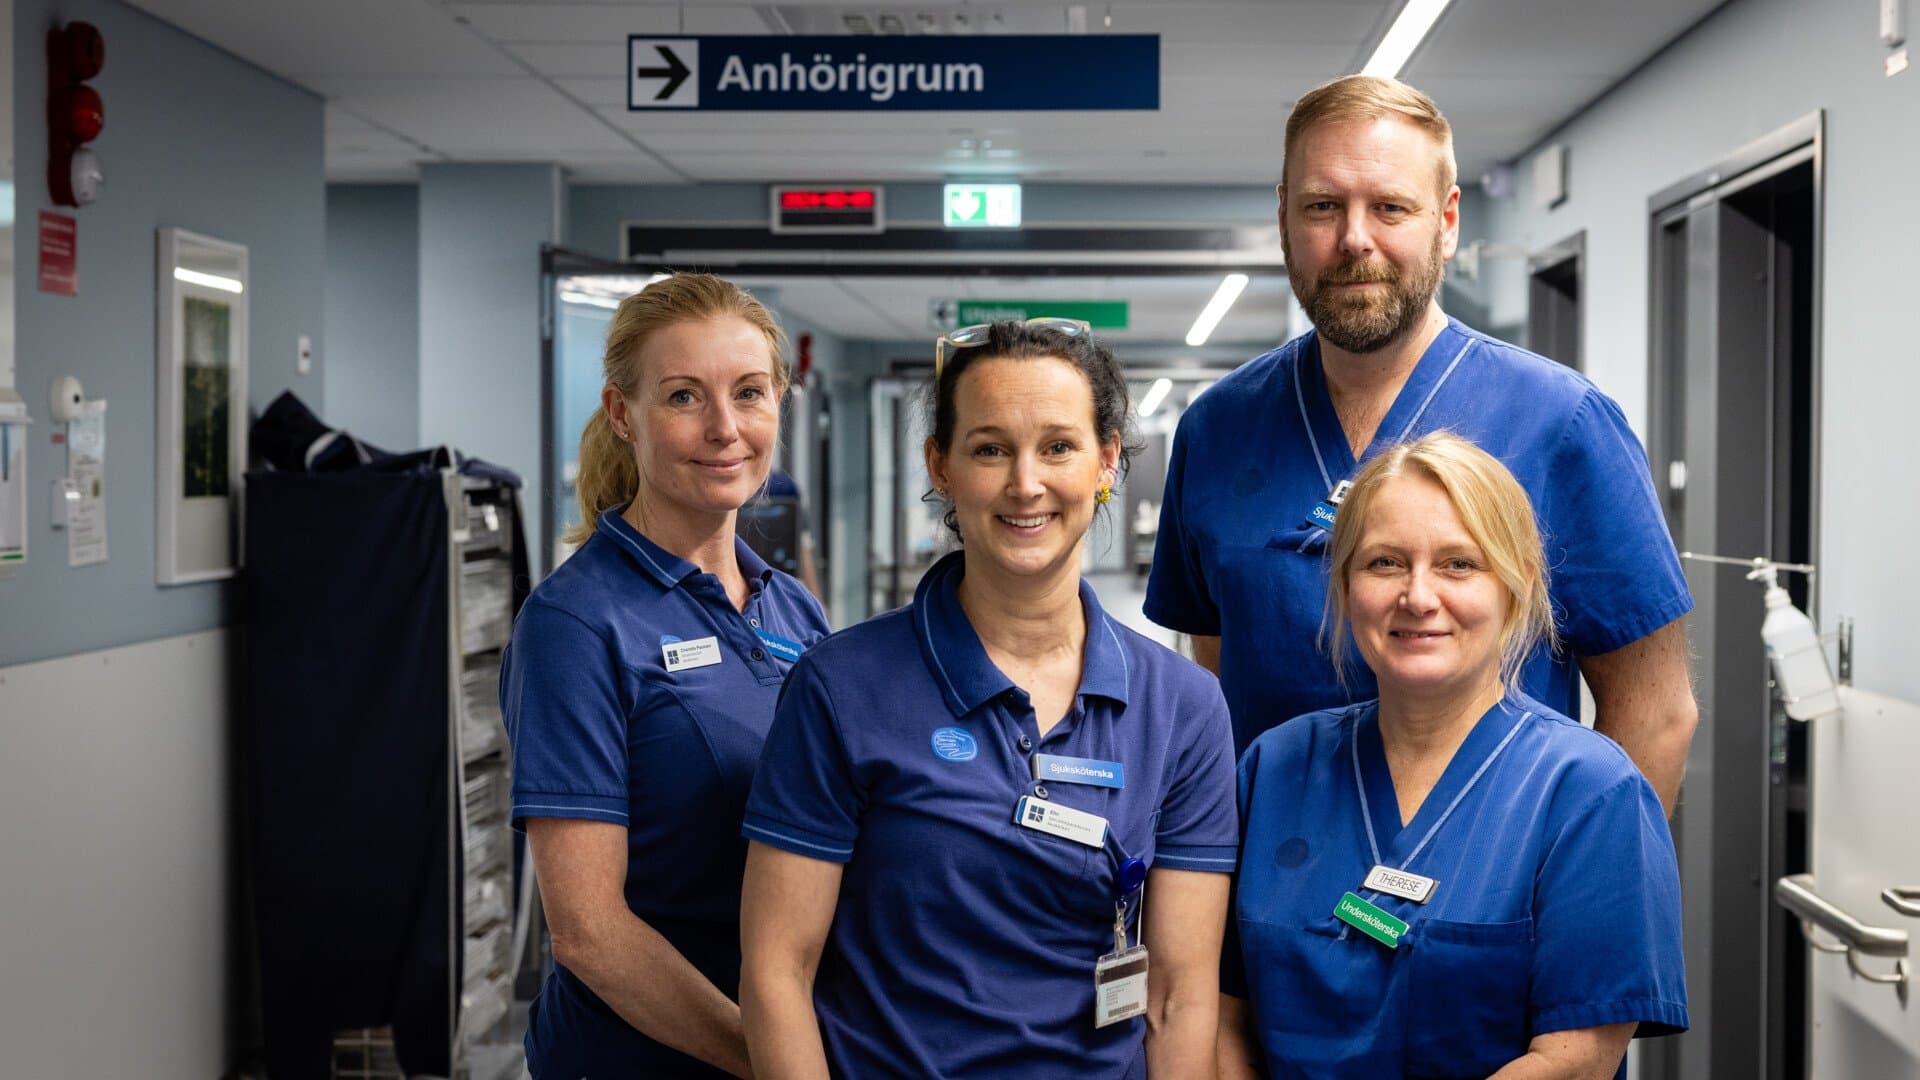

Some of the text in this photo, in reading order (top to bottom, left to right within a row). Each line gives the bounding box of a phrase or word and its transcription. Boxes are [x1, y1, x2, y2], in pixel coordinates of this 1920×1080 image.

[716, 52, 985, 101] Anhörigrum
[1049, 762, 1114, 779] Sjuksköterska
[1378, 872, 1421, 893] THERESE
[1341, 900, 1399, 939] Undersköterska
